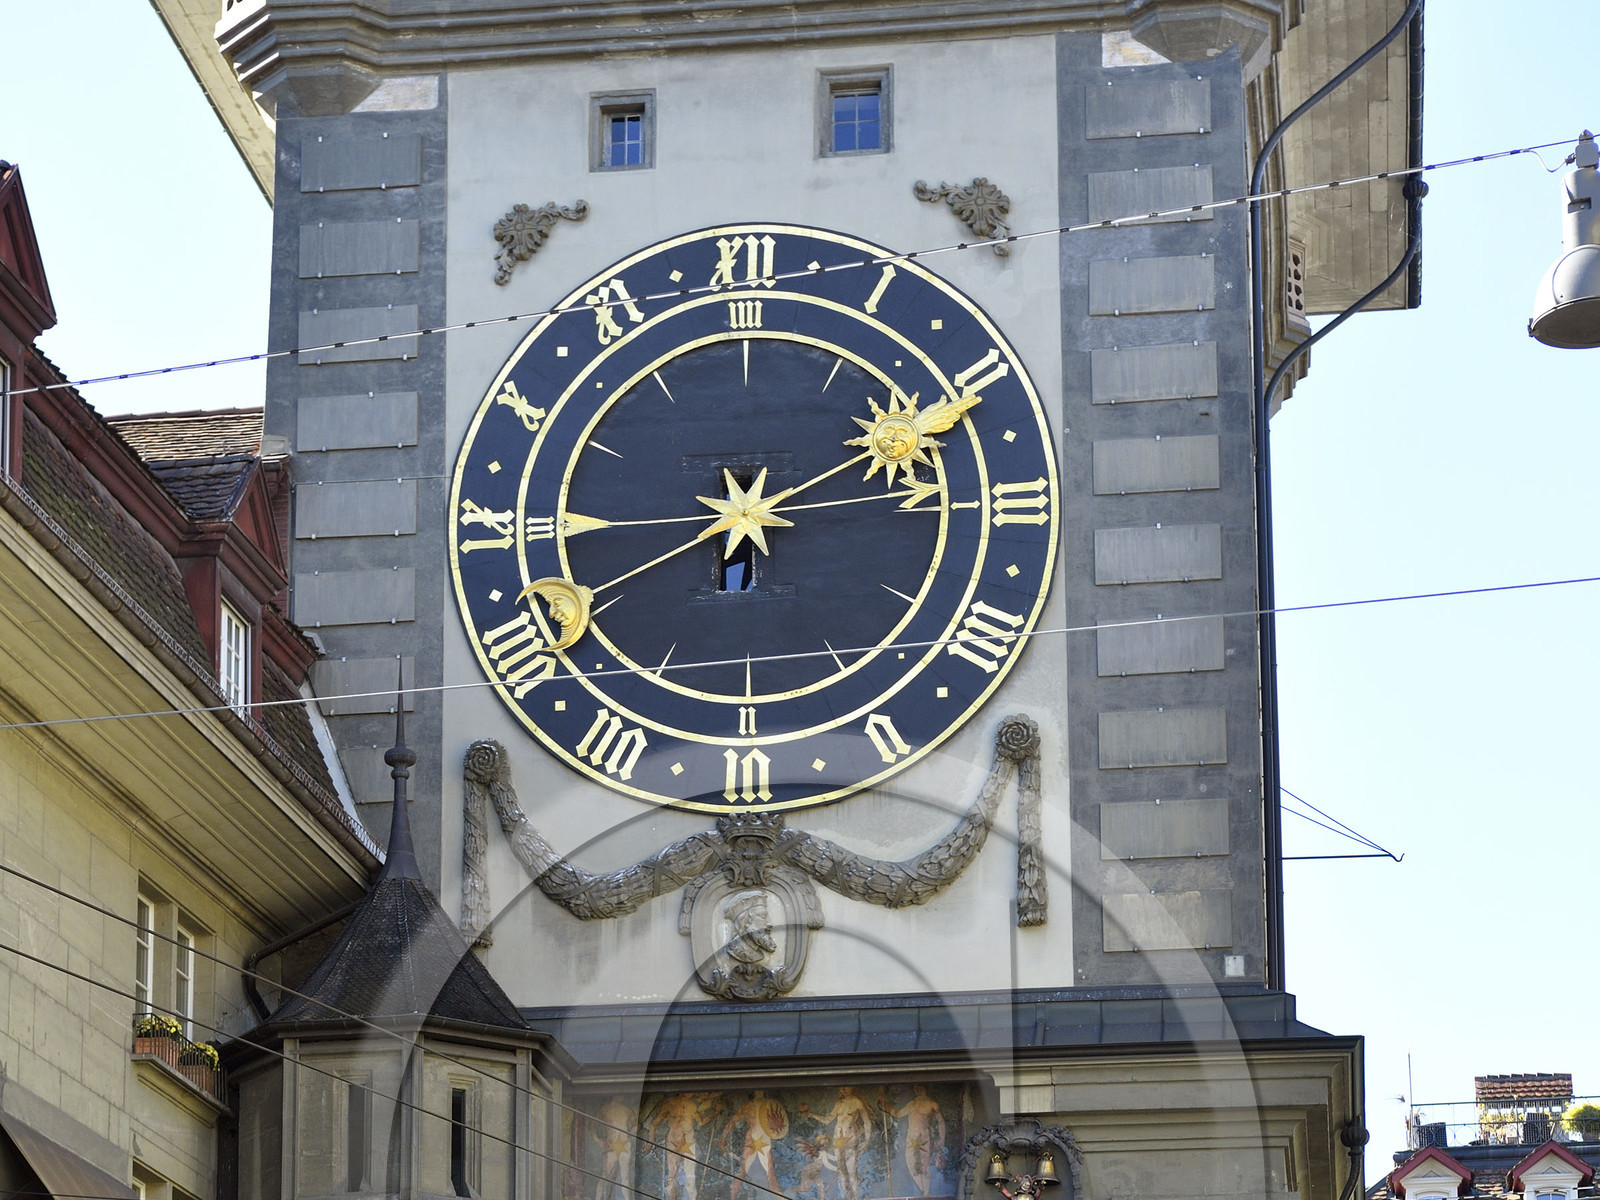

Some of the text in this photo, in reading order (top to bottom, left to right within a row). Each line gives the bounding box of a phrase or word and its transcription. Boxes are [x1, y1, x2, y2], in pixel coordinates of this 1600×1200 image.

[710, 235, 777, 291] XII
[585, 279, 645, 345] XI
[865, 265, 897, 313] I
[954, 348, 1009, 398] II
[992, 477, 1049, 526] III
